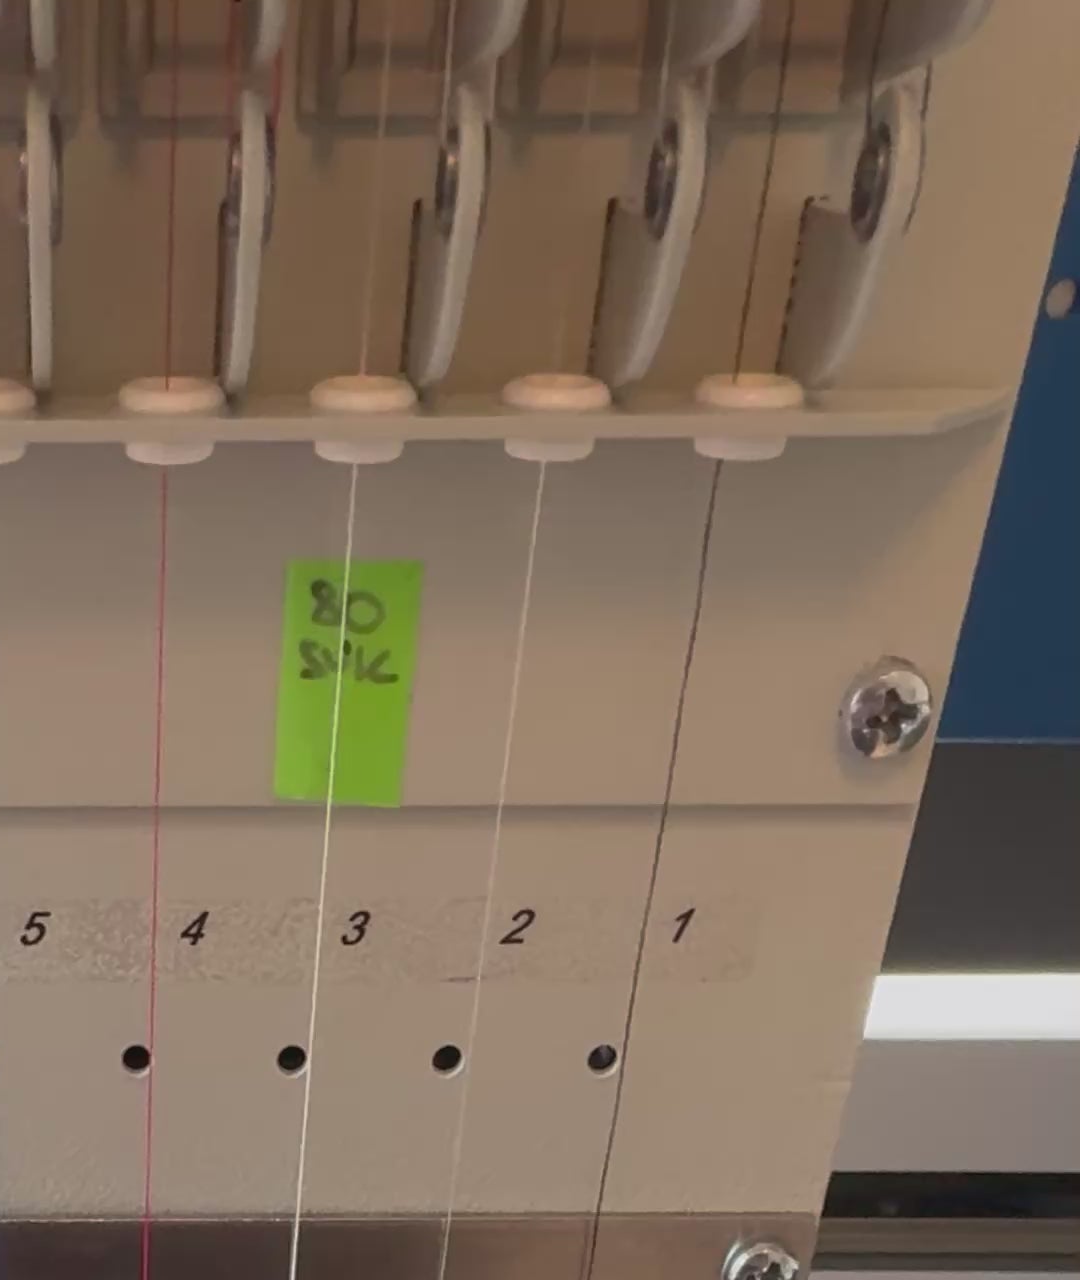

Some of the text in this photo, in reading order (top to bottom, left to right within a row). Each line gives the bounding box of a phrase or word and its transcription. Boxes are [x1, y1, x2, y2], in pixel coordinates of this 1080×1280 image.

[310, 578, 386, 635] 80
[19, 911, 52, 947] 5
[180, 910, 210, 946] 4
[340, 910, 371, 946] 3
[499, 909, 537, 945] 2
[672, 908, 696, 944] 1
